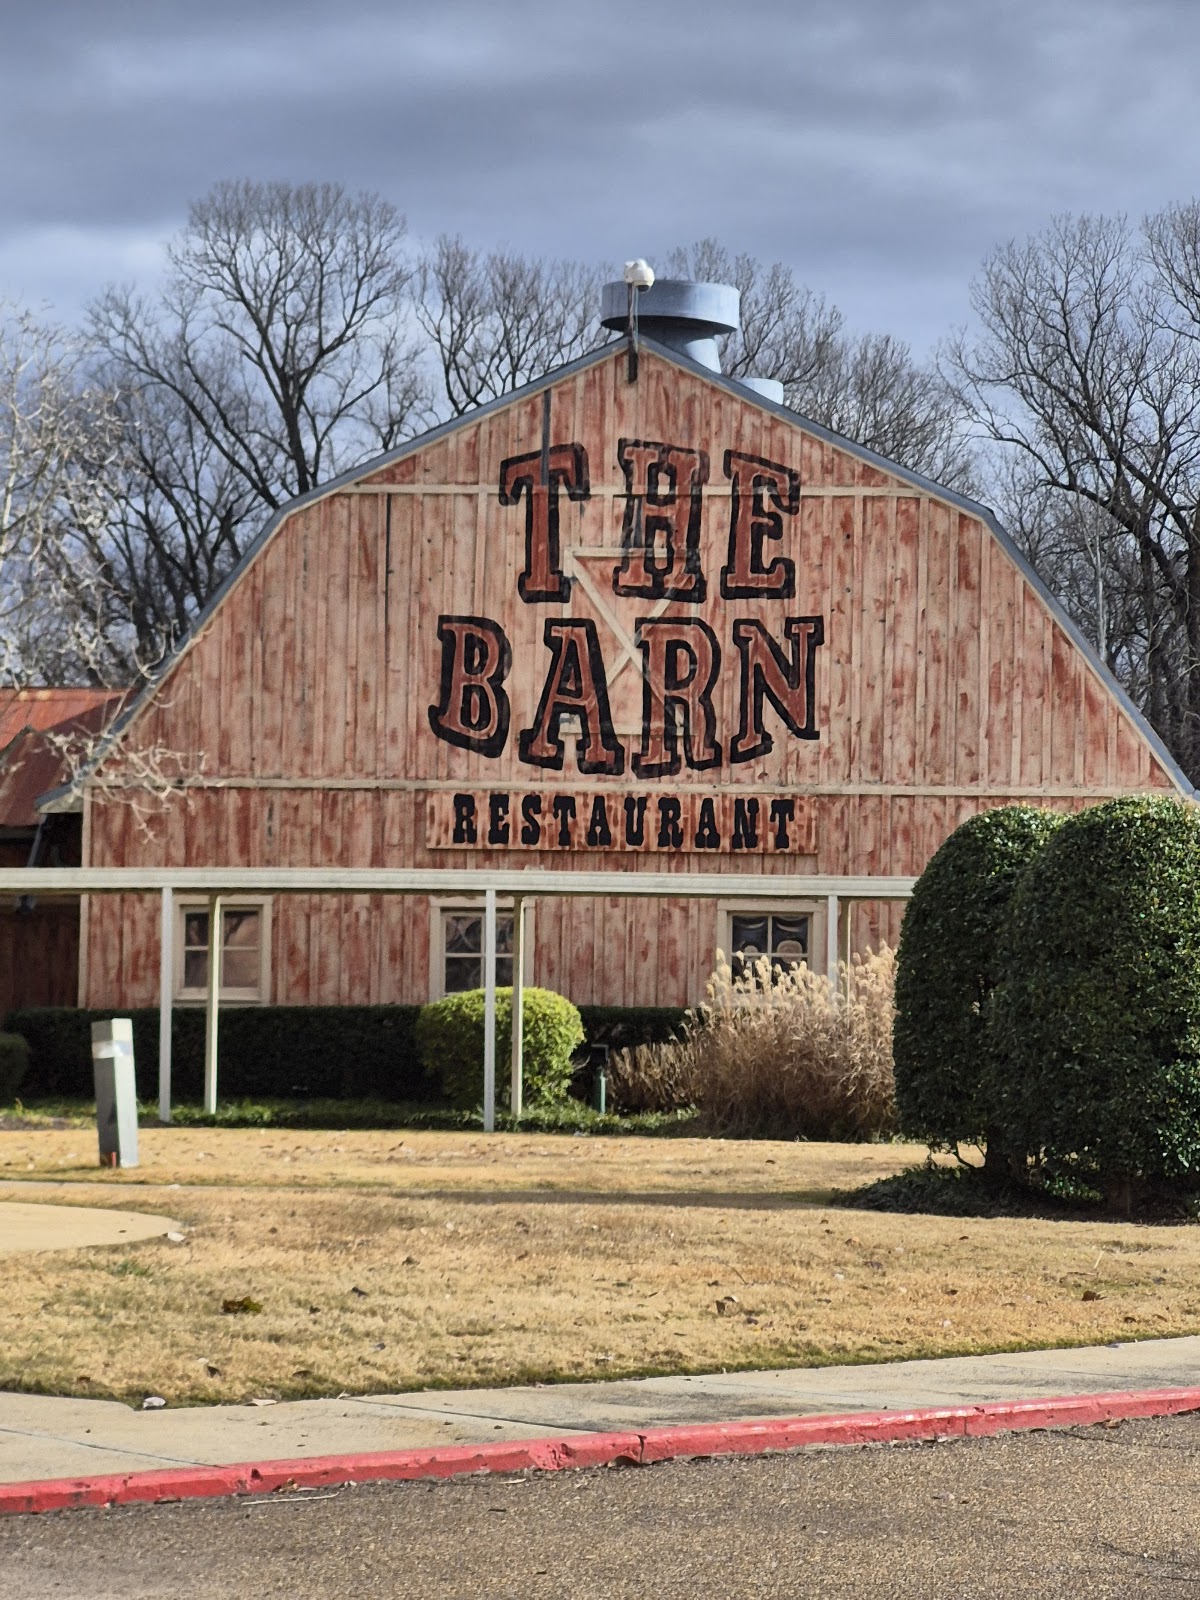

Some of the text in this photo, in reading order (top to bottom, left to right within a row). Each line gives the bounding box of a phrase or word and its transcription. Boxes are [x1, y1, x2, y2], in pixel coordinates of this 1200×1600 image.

[499, 438, 800, 603] THE
[428, 615, 825, 779] BARN
[452, 793, 796, 849] RESTAURANT
